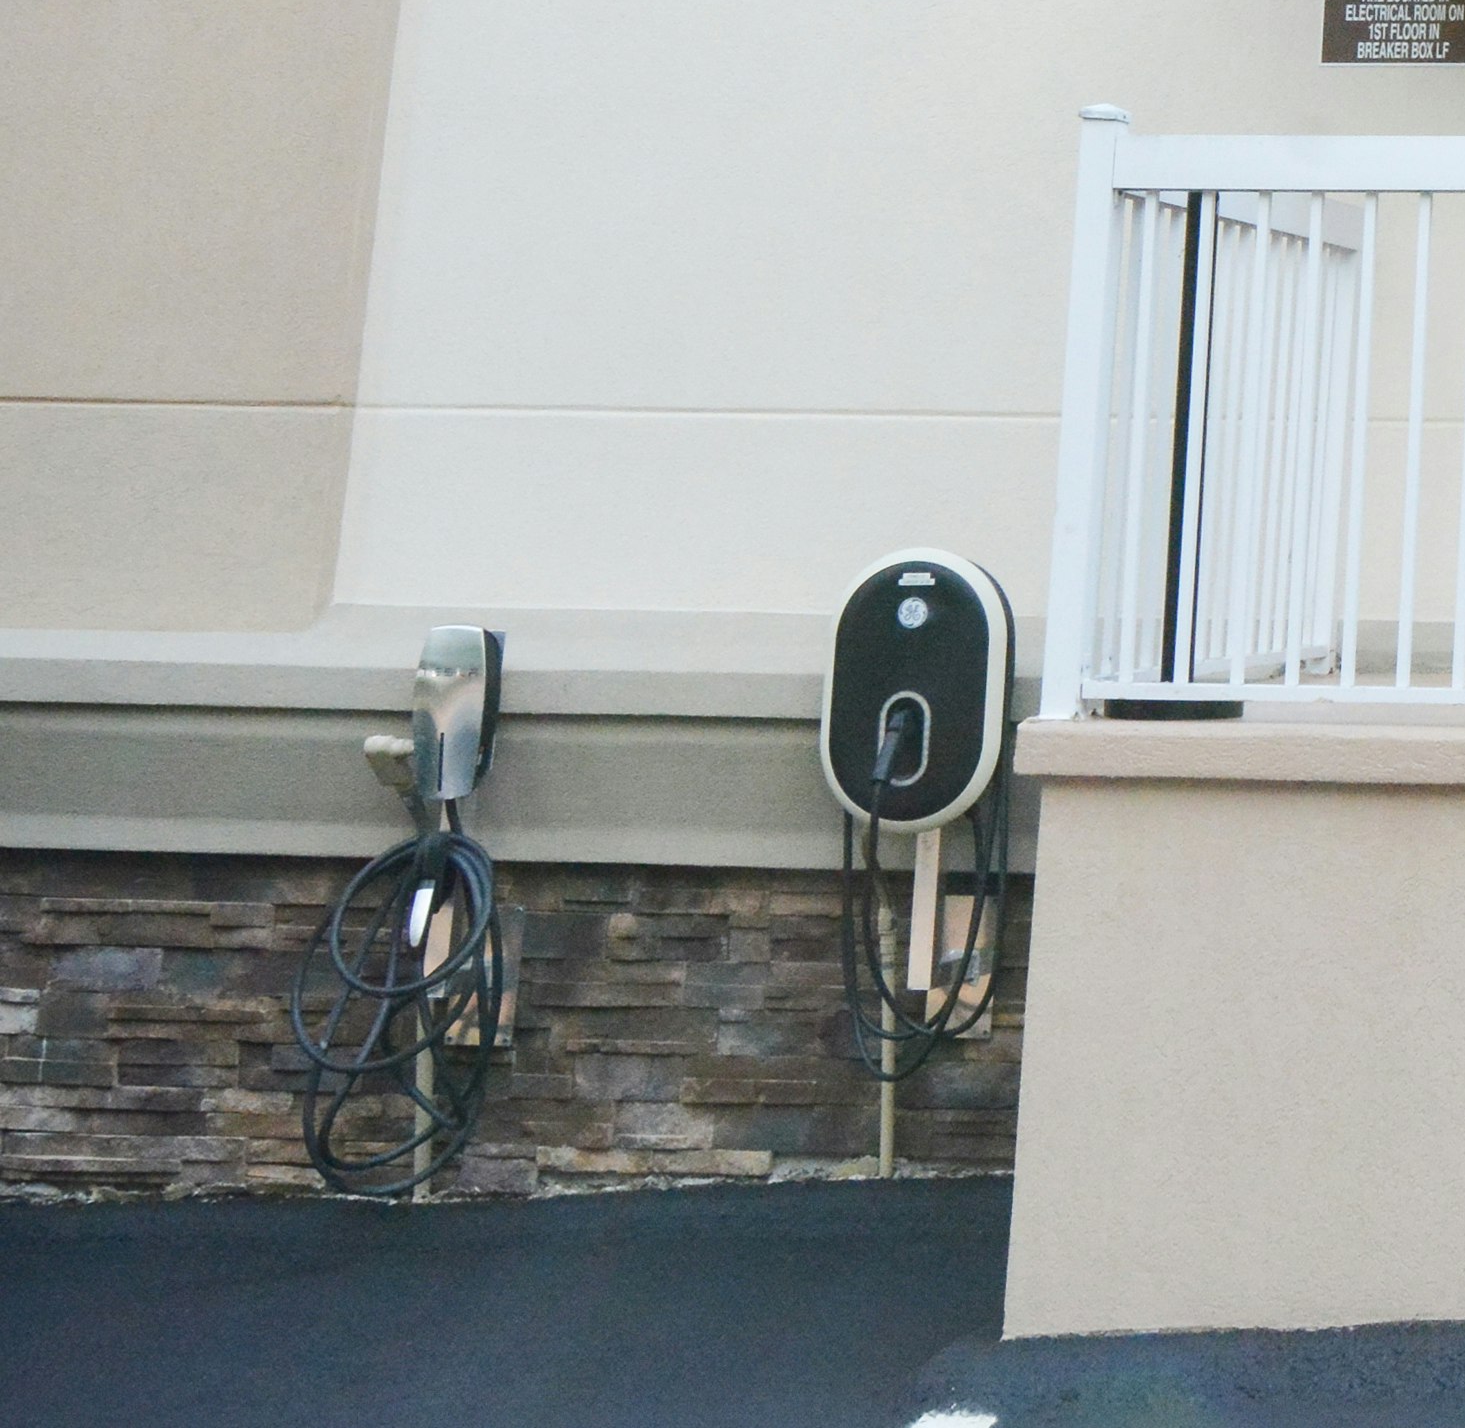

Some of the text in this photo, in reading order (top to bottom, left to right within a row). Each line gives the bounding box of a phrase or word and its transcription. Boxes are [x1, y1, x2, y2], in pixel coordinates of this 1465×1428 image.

[1345, 5, 1464, 21] ELECTRICAL ROOM ON
[1369, 23, 1439, 40] 1ST FLOOR IN
[1357, 42, 1449, 58] BREAKER BOX LF
